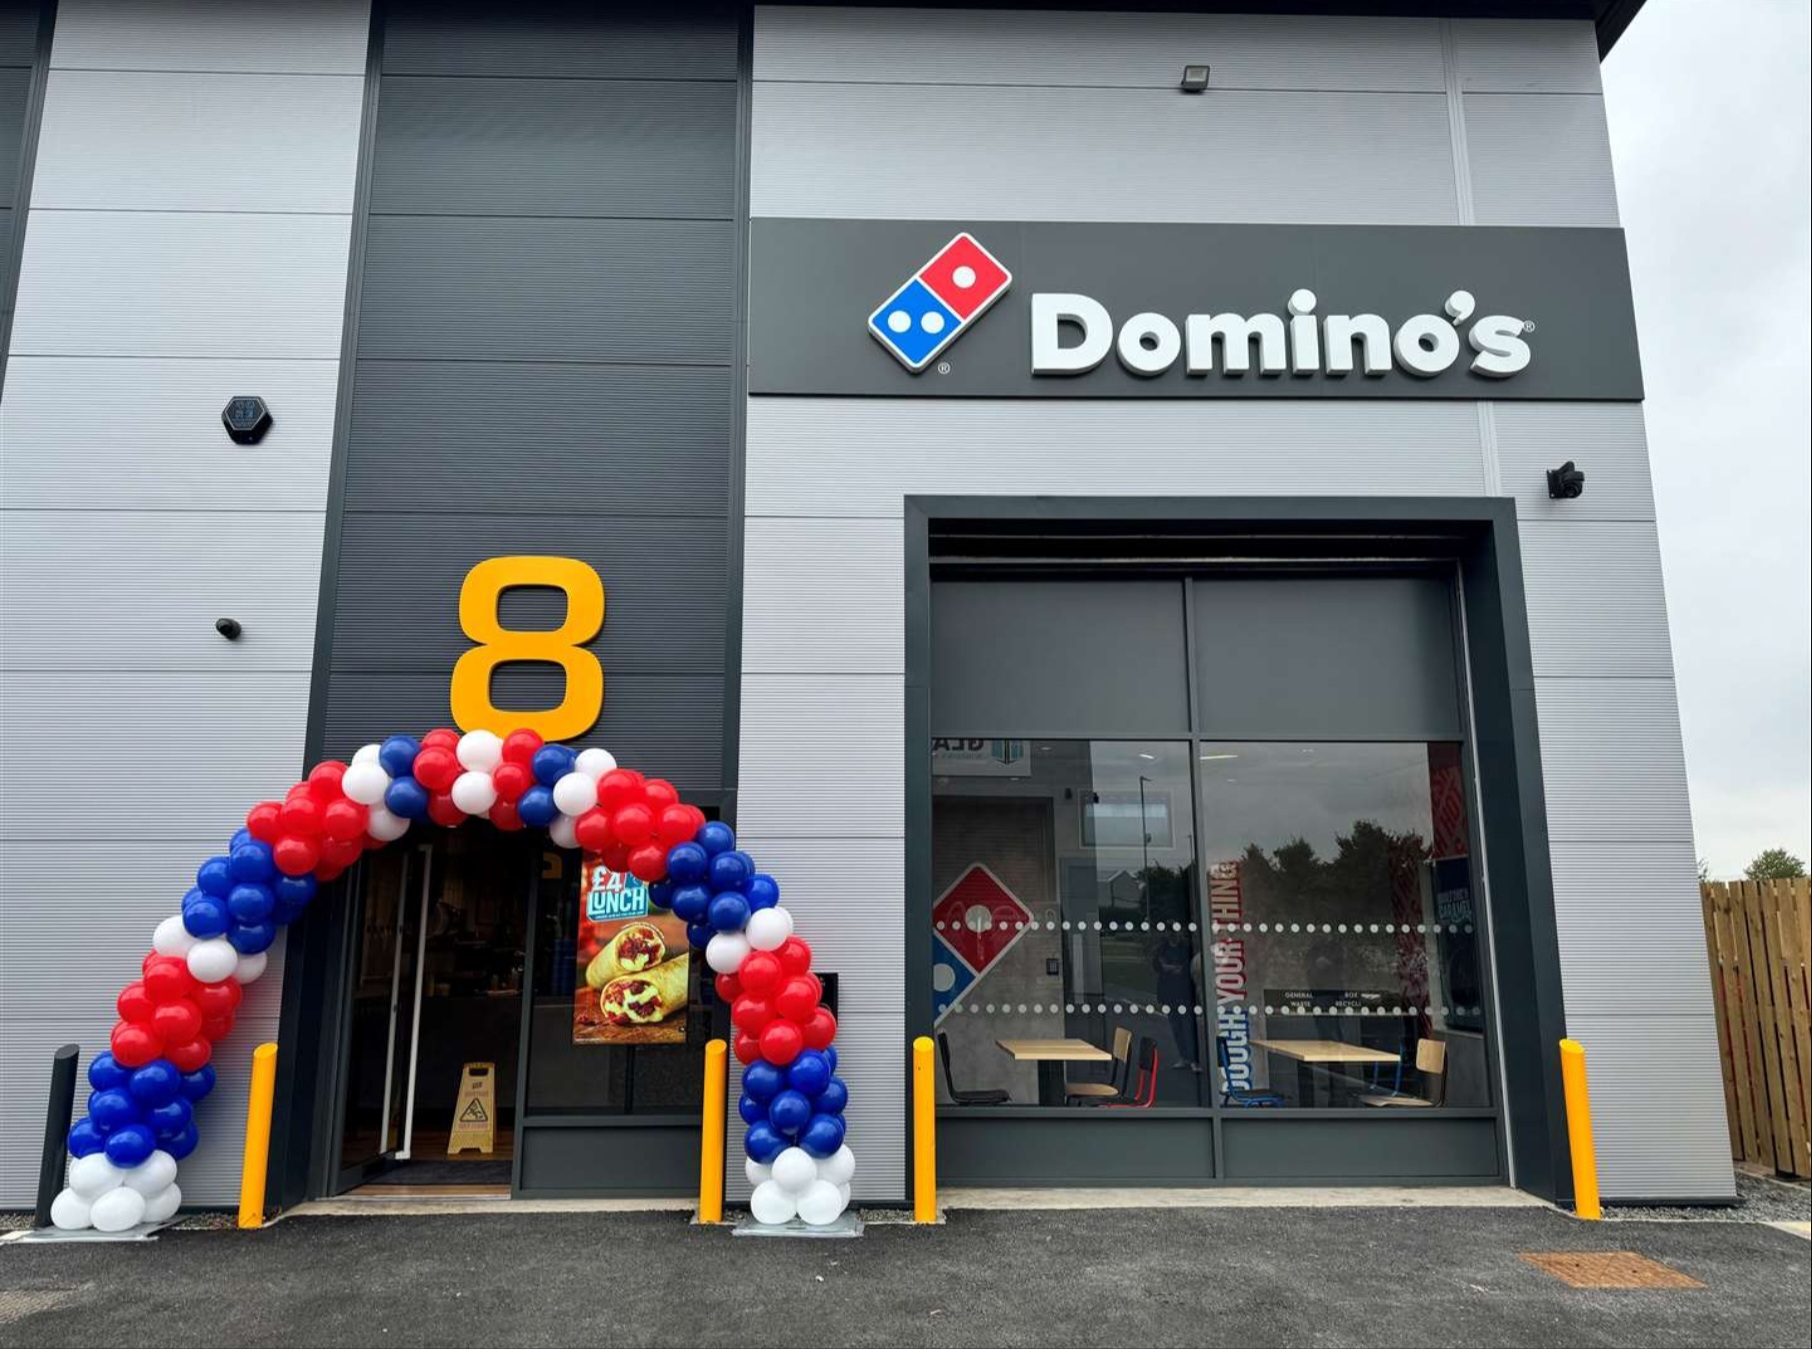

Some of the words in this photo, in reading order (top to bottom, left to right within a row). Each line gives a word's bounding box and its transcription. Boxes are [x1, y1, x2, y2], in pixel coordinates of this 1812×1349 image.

[1031, 289, 1531, 378] Domino's
[450, 555, 605, 742] 8
[588, 887, 646, 915] LUNCH
[592, 865, 622, 892] £4
[1209, 862, 1242, 935] THING
[1213, 939, 1247, 1003] YOUR
[1284, 991, 1312, 999] GENERAL
[1344, 991, 1358, 999] BOX
